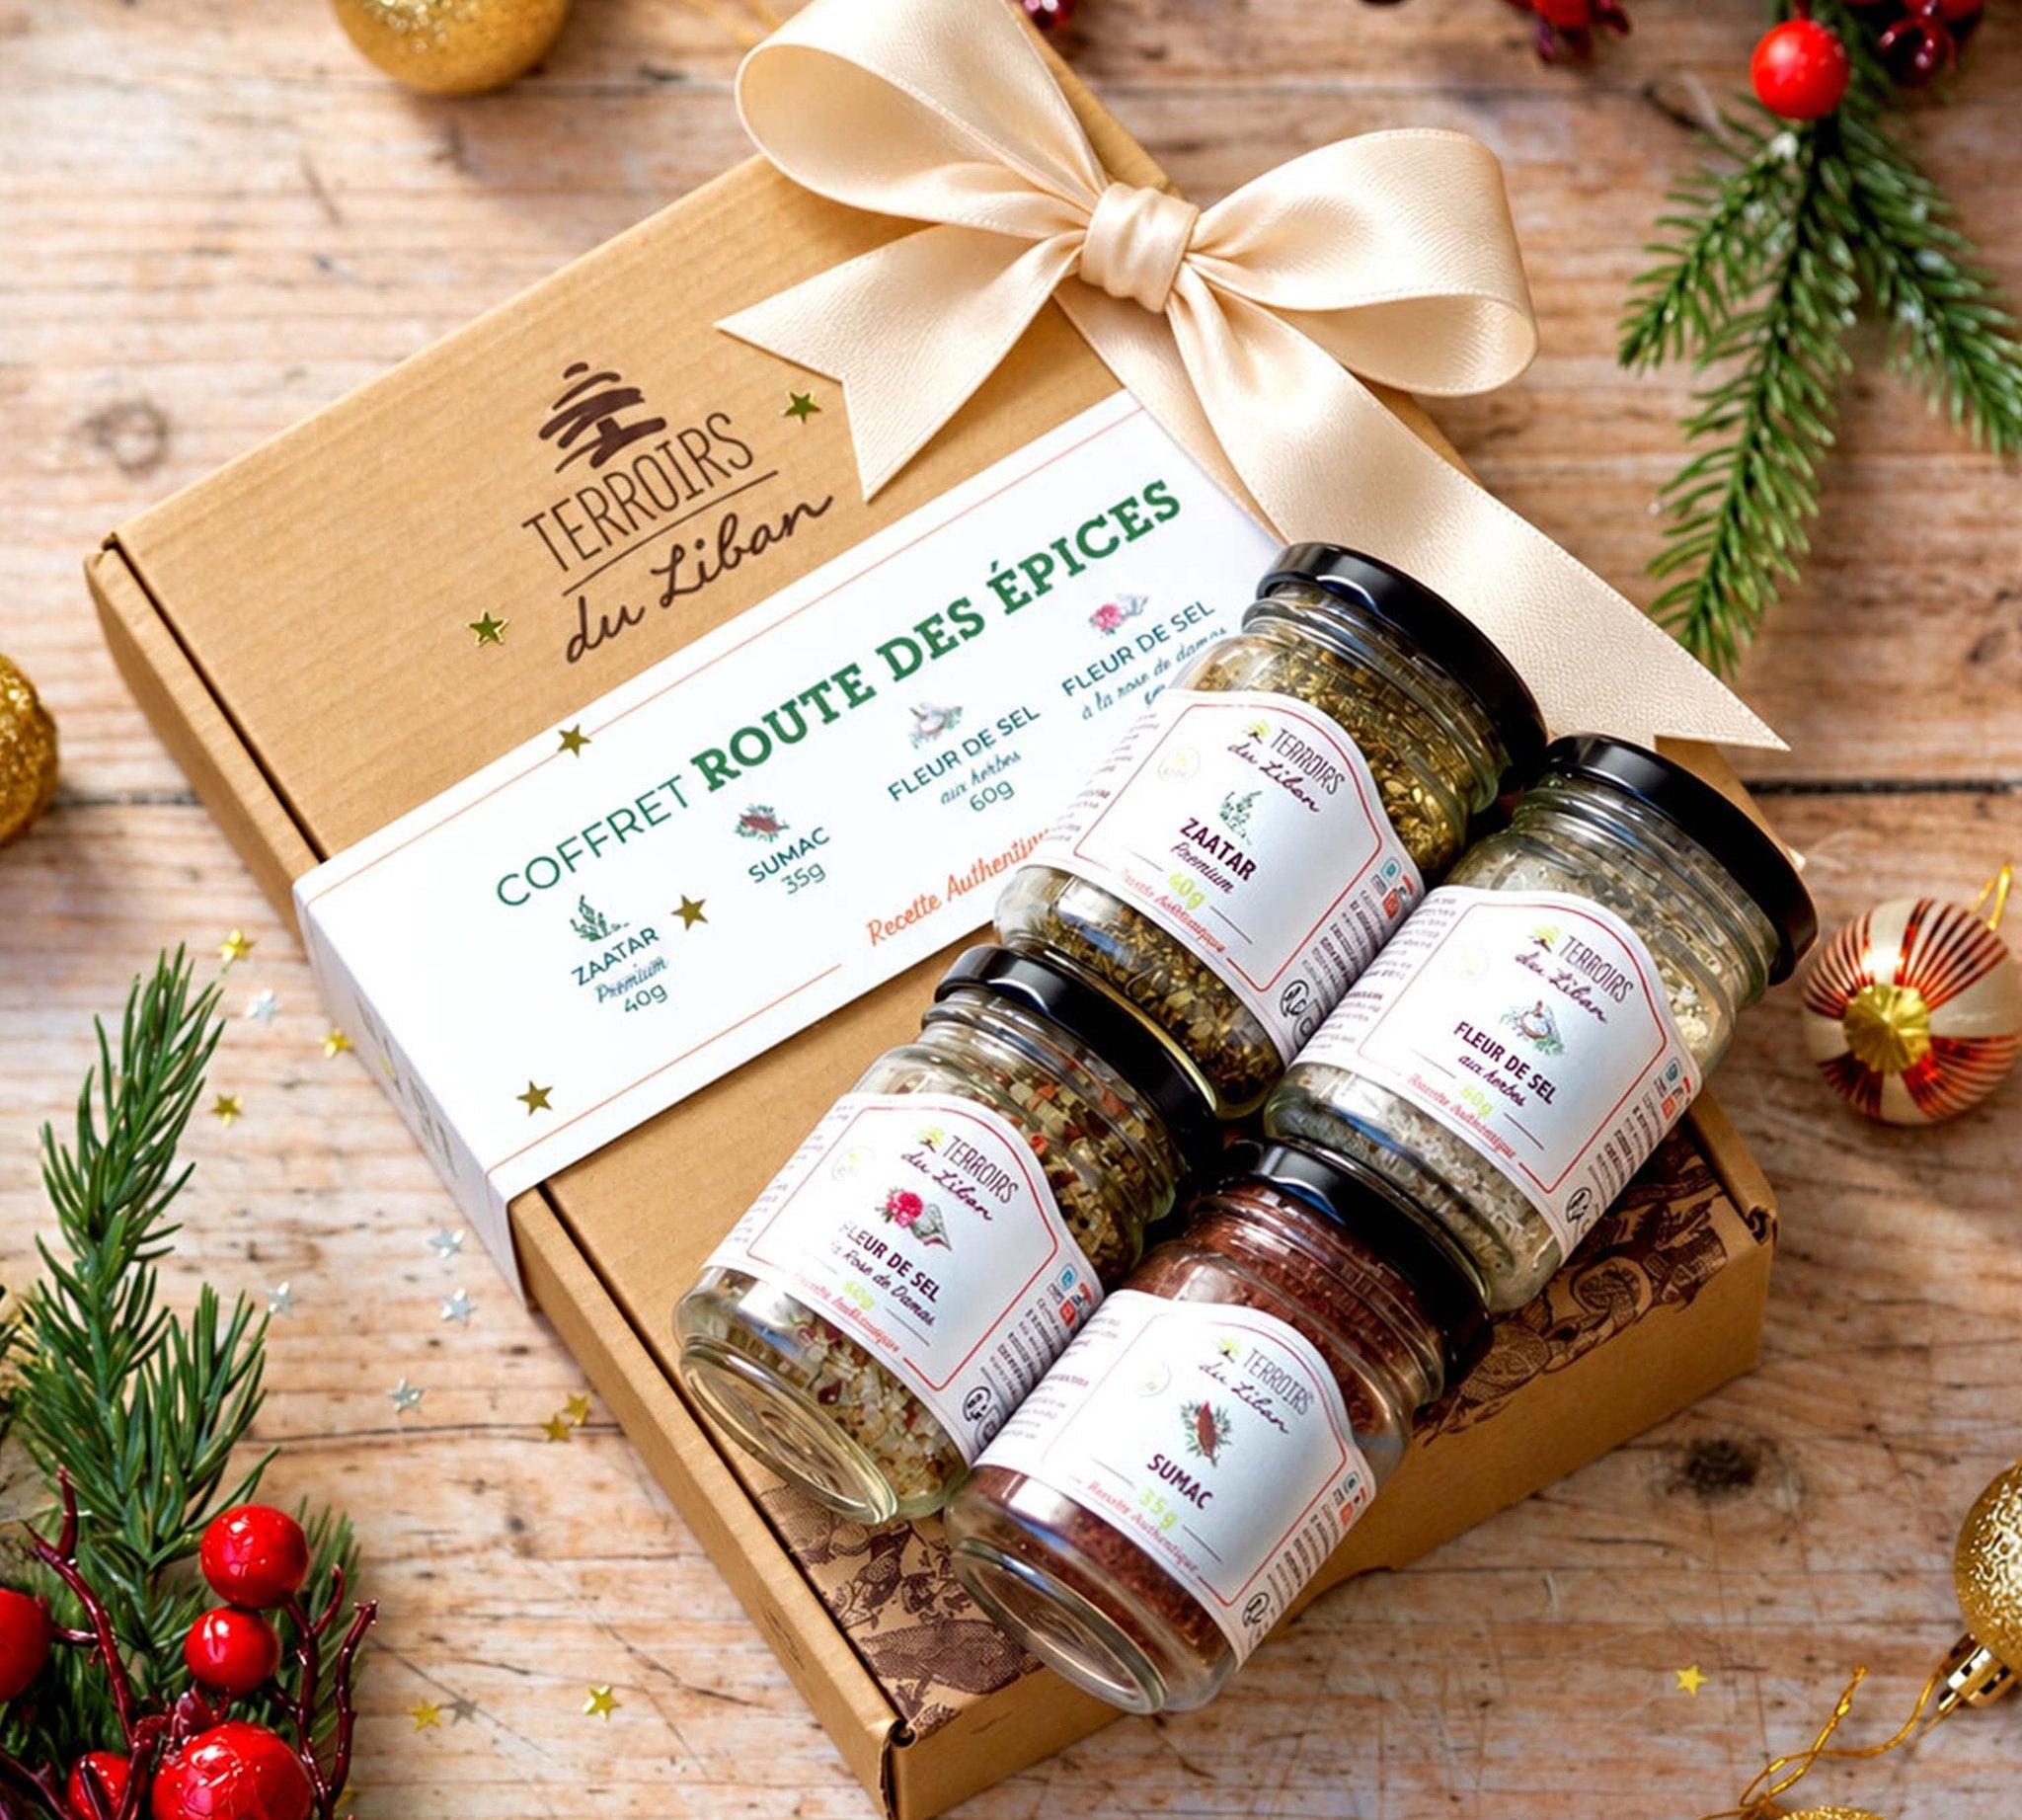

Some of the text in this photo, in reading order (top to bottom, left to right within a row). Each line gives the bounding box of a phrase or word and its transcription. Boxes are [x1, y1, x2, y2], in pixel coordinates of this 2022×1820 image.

[521, 412, 754, 572] TERROIRS
[567, 496, 833, 664] du Liban
[1061, 646, 1135, 697] FLEUR
[1134, 624, 1171, 654] DE
[1170, 600, 1215, 633] SEL
[497, 479, 1181, 906] COFFRET ROUTE DES ÉPICES
[887, 706, 1041, 802] FLEUR DE SEL
[1259, 760, 1320, 812] Liban
[1271, 727, 1345, 795] TERROIRS
[970, 780, 1015, 812] 60g
[747, 827, 830, 884] SUMAC
[781, 862, 826, 895] 35g
[1180, 817, 1257, 881] ZAATAR
[867, 829, 1049, 946] Recette Authenti
[571, 927, 660, 986] ZAATAR
[1559, 935, 1634, 1003] TERROIRS
[625, 985, 668, 1012] 40g
[1453, 1021, 1556, 1105] FLEUR DE SEL
[932, 1169, 992, 1221] Liban
[943, 1135, 1019, 1204] TERROIRS
[872, 1274, 892, 1290] de
[891, 1285, 936, 1326] Damas
[887, 1252, 913, 1278] DE
[910, 1271, 940, 1303] SEL
[1231, 1381, 1289, 1434] Liban
[1243, 1347, 1314, 1415] TERROIRS
[1146, 1454, 1213, 1510] SUMAC
